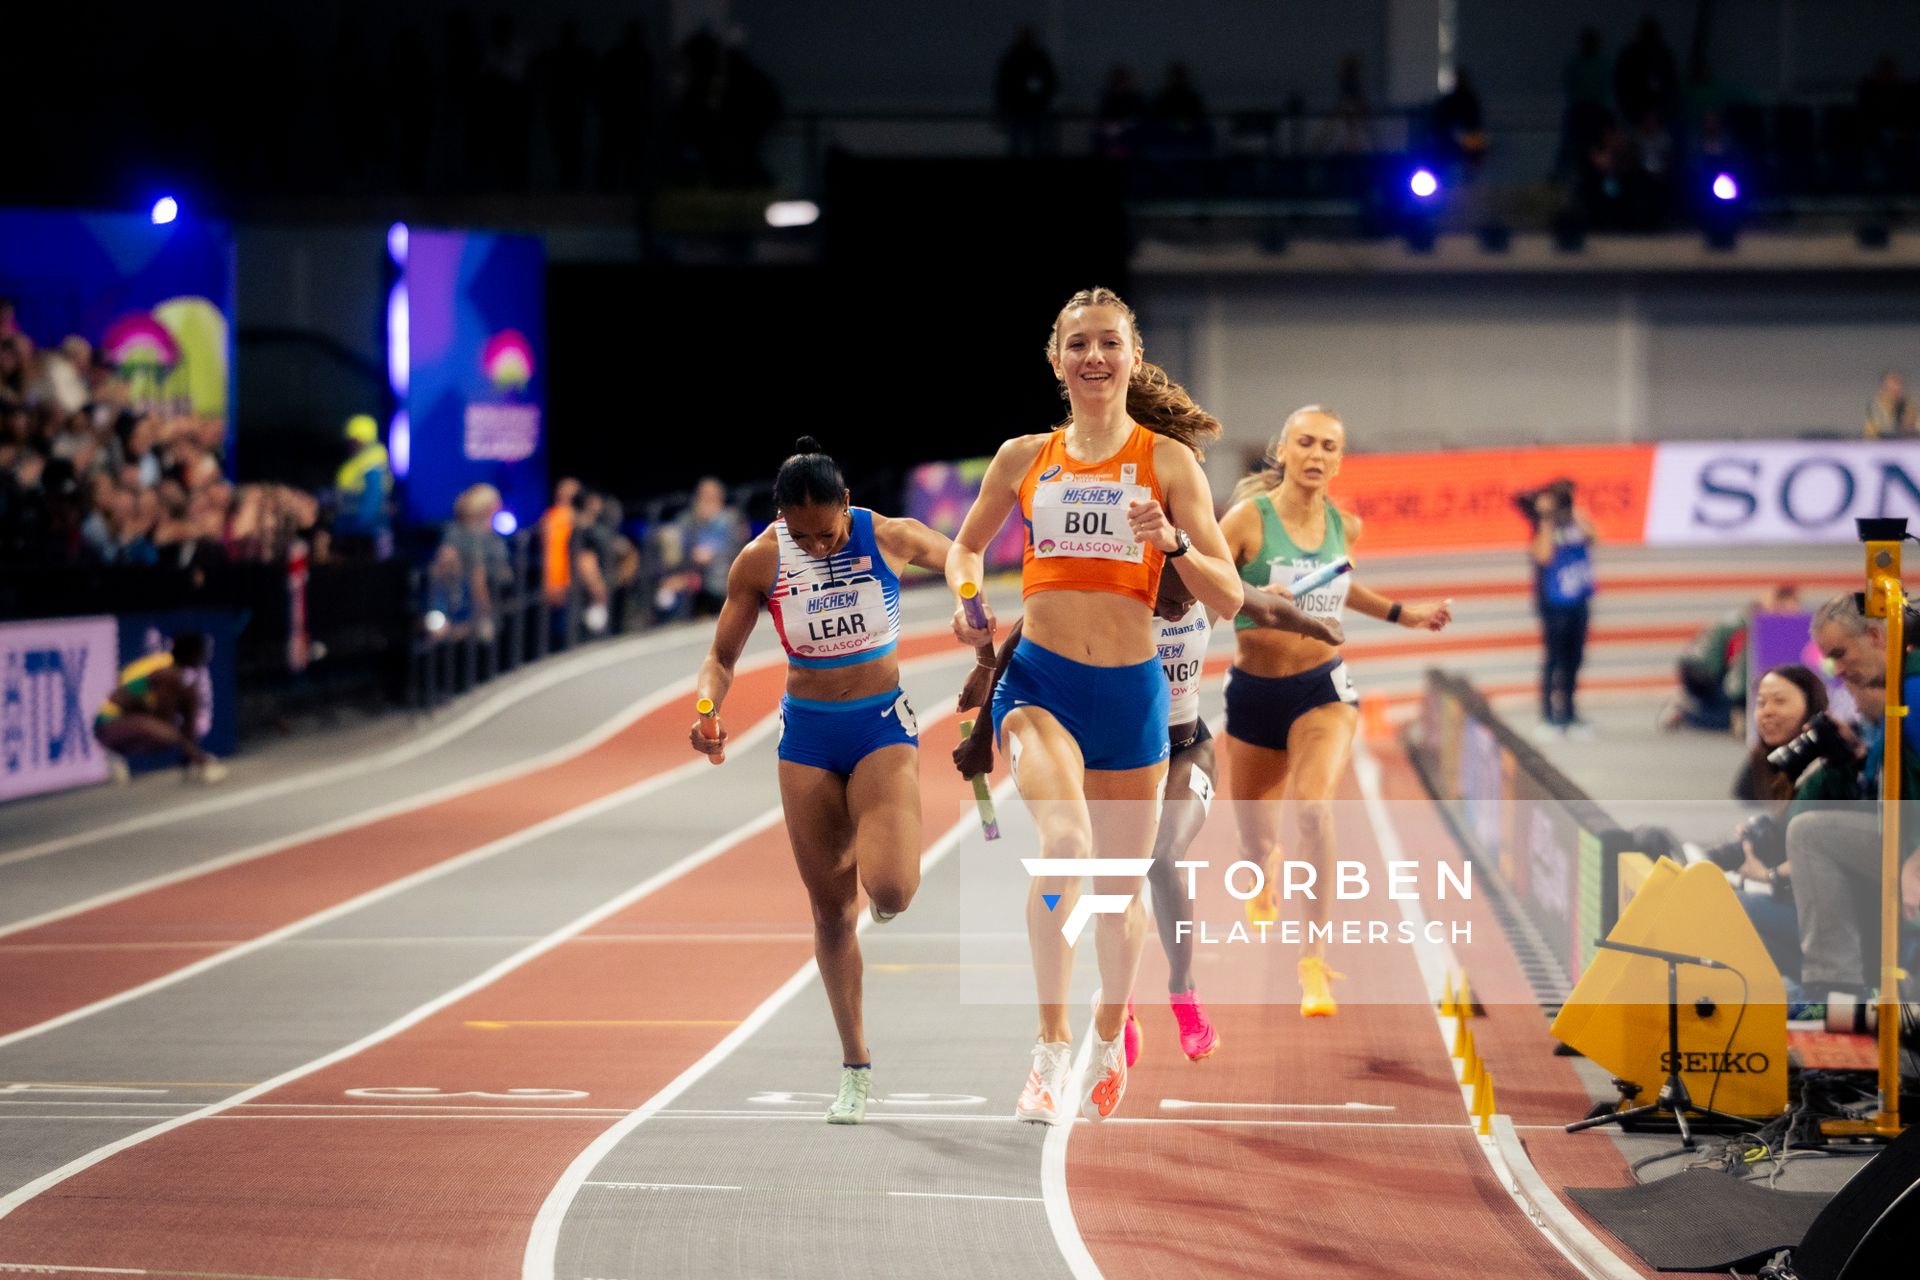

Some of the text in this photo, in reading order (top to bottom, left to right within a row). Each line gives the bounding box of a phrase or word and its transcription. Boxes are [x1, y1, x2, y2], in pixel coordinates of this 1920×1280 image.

[1062, 486, 1123, 505] HI-CHEW
[1065, 511, 1114, 535] BOL
[1060, 541, 1139, 557] GLASGOW 24
[808, 613, 866, 641] LEAR
[1161, 624, 1195, 638] Allianz
[818, 633, 872, 653] GLASGOW
[1660, 1051, 1769, 1074] SEIKO
